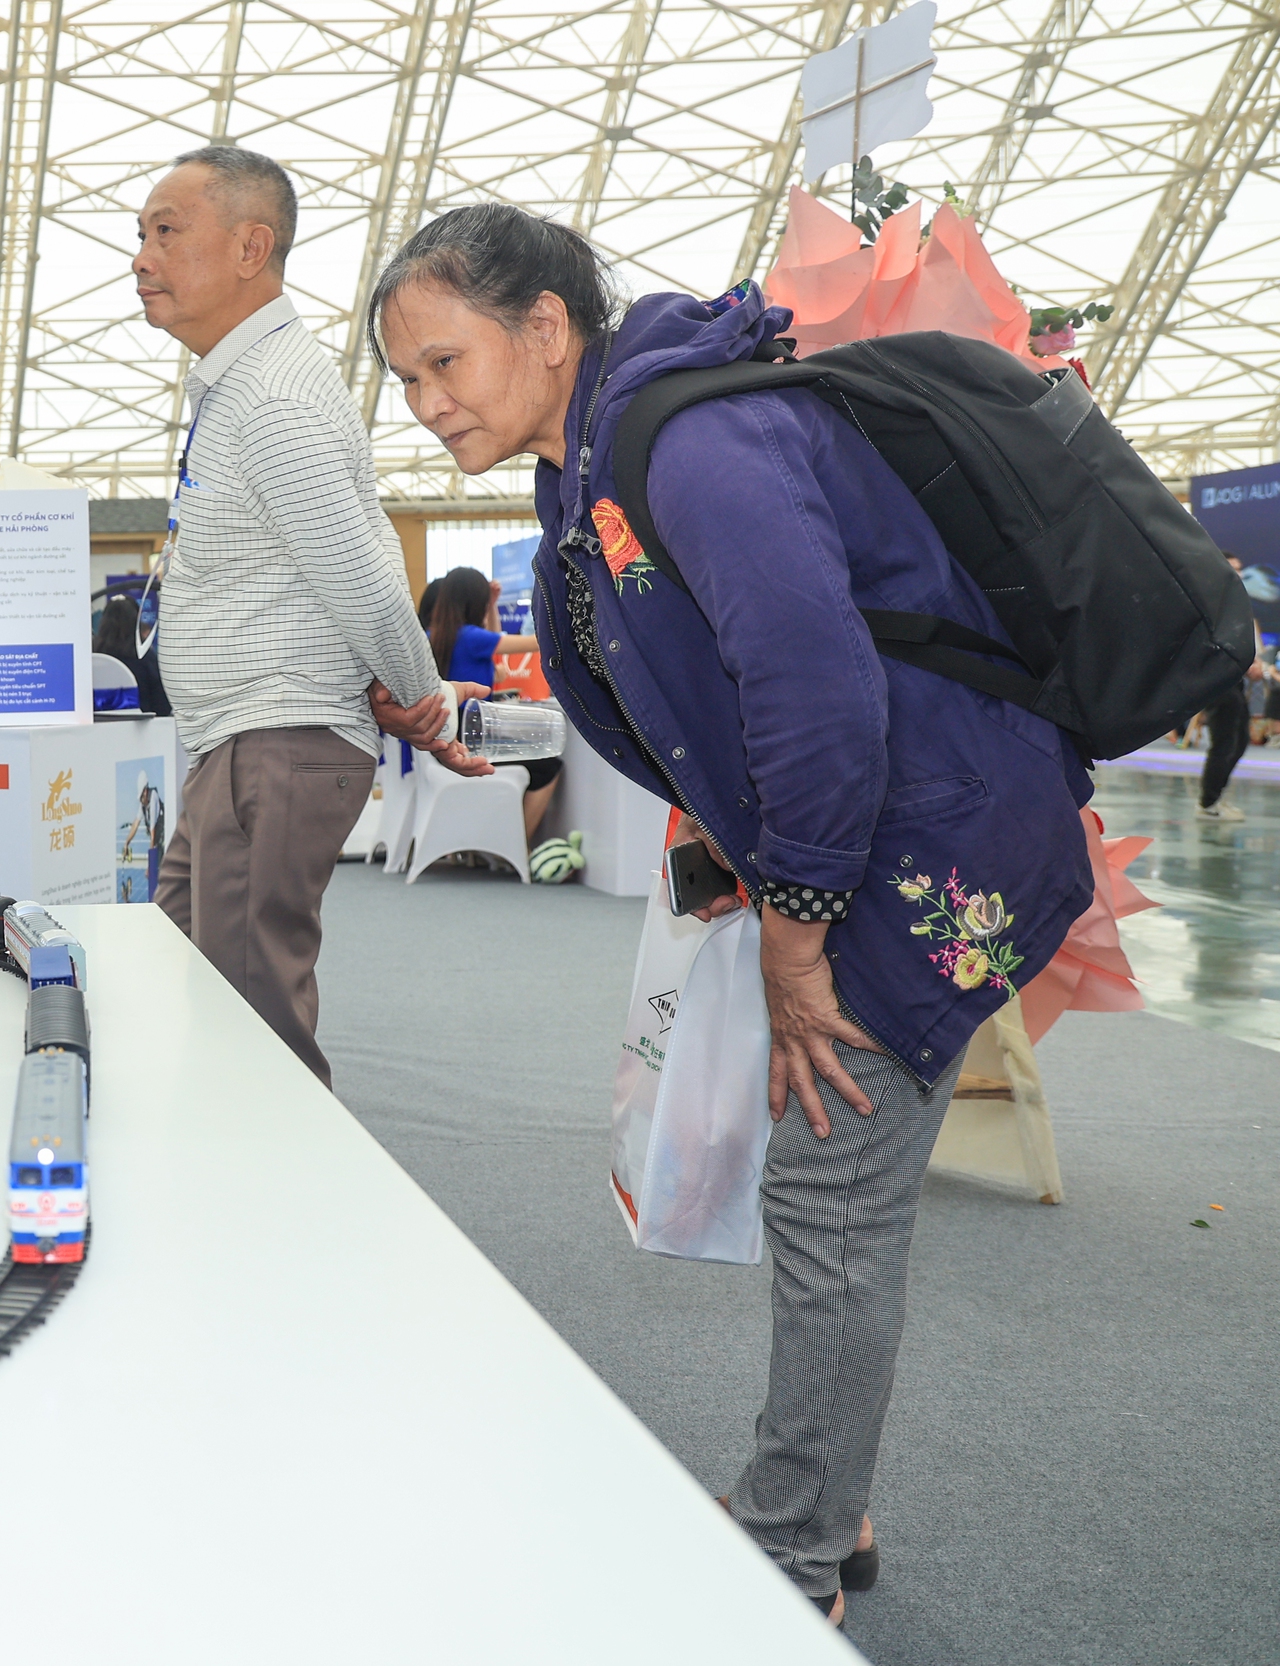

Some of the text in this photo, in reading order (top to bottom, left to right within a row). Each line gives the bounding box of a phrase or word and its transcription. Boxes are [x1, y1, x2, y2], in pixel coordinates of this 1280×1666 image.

[12, 512, 22, 521] CỔ
[24, 512, 46, 521] PHẦN
[61, 512, 75, 520] KHÍ
[5, 524, 19, 532] HẢI
